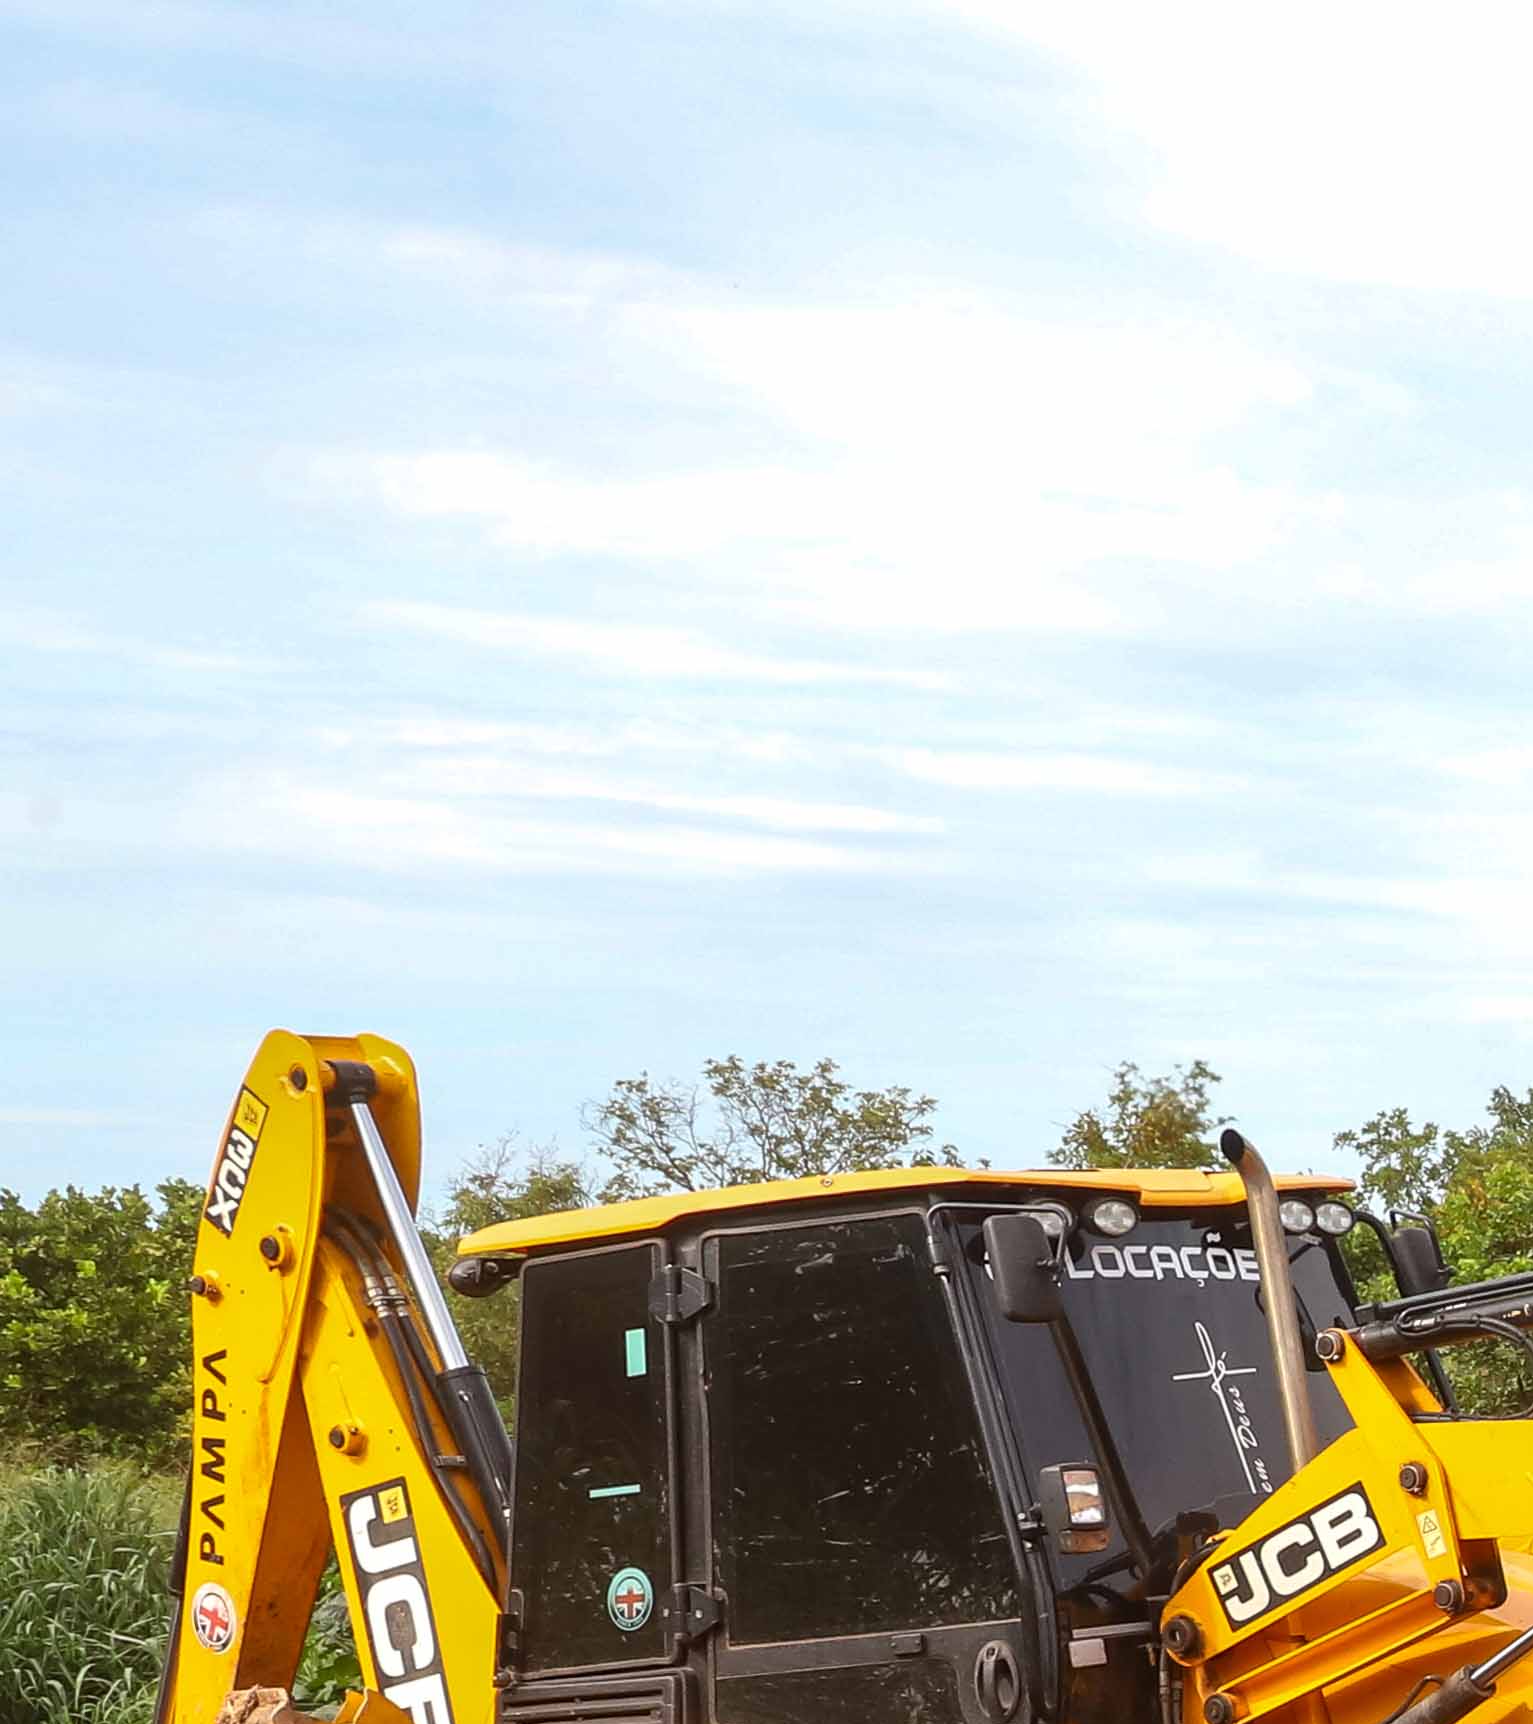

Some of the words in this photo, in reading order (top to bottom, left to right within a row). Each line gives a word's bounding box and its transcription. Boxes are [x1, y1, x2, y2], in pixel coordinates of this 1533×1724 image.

[206, 1128, 255, 1233] 3CX
[1063, 1231, 1261, 1287] LOCAÇÕE
[1228, 1385, 1258, 1449] Deus
[1224, 1492, 1380, 1622] JCB
